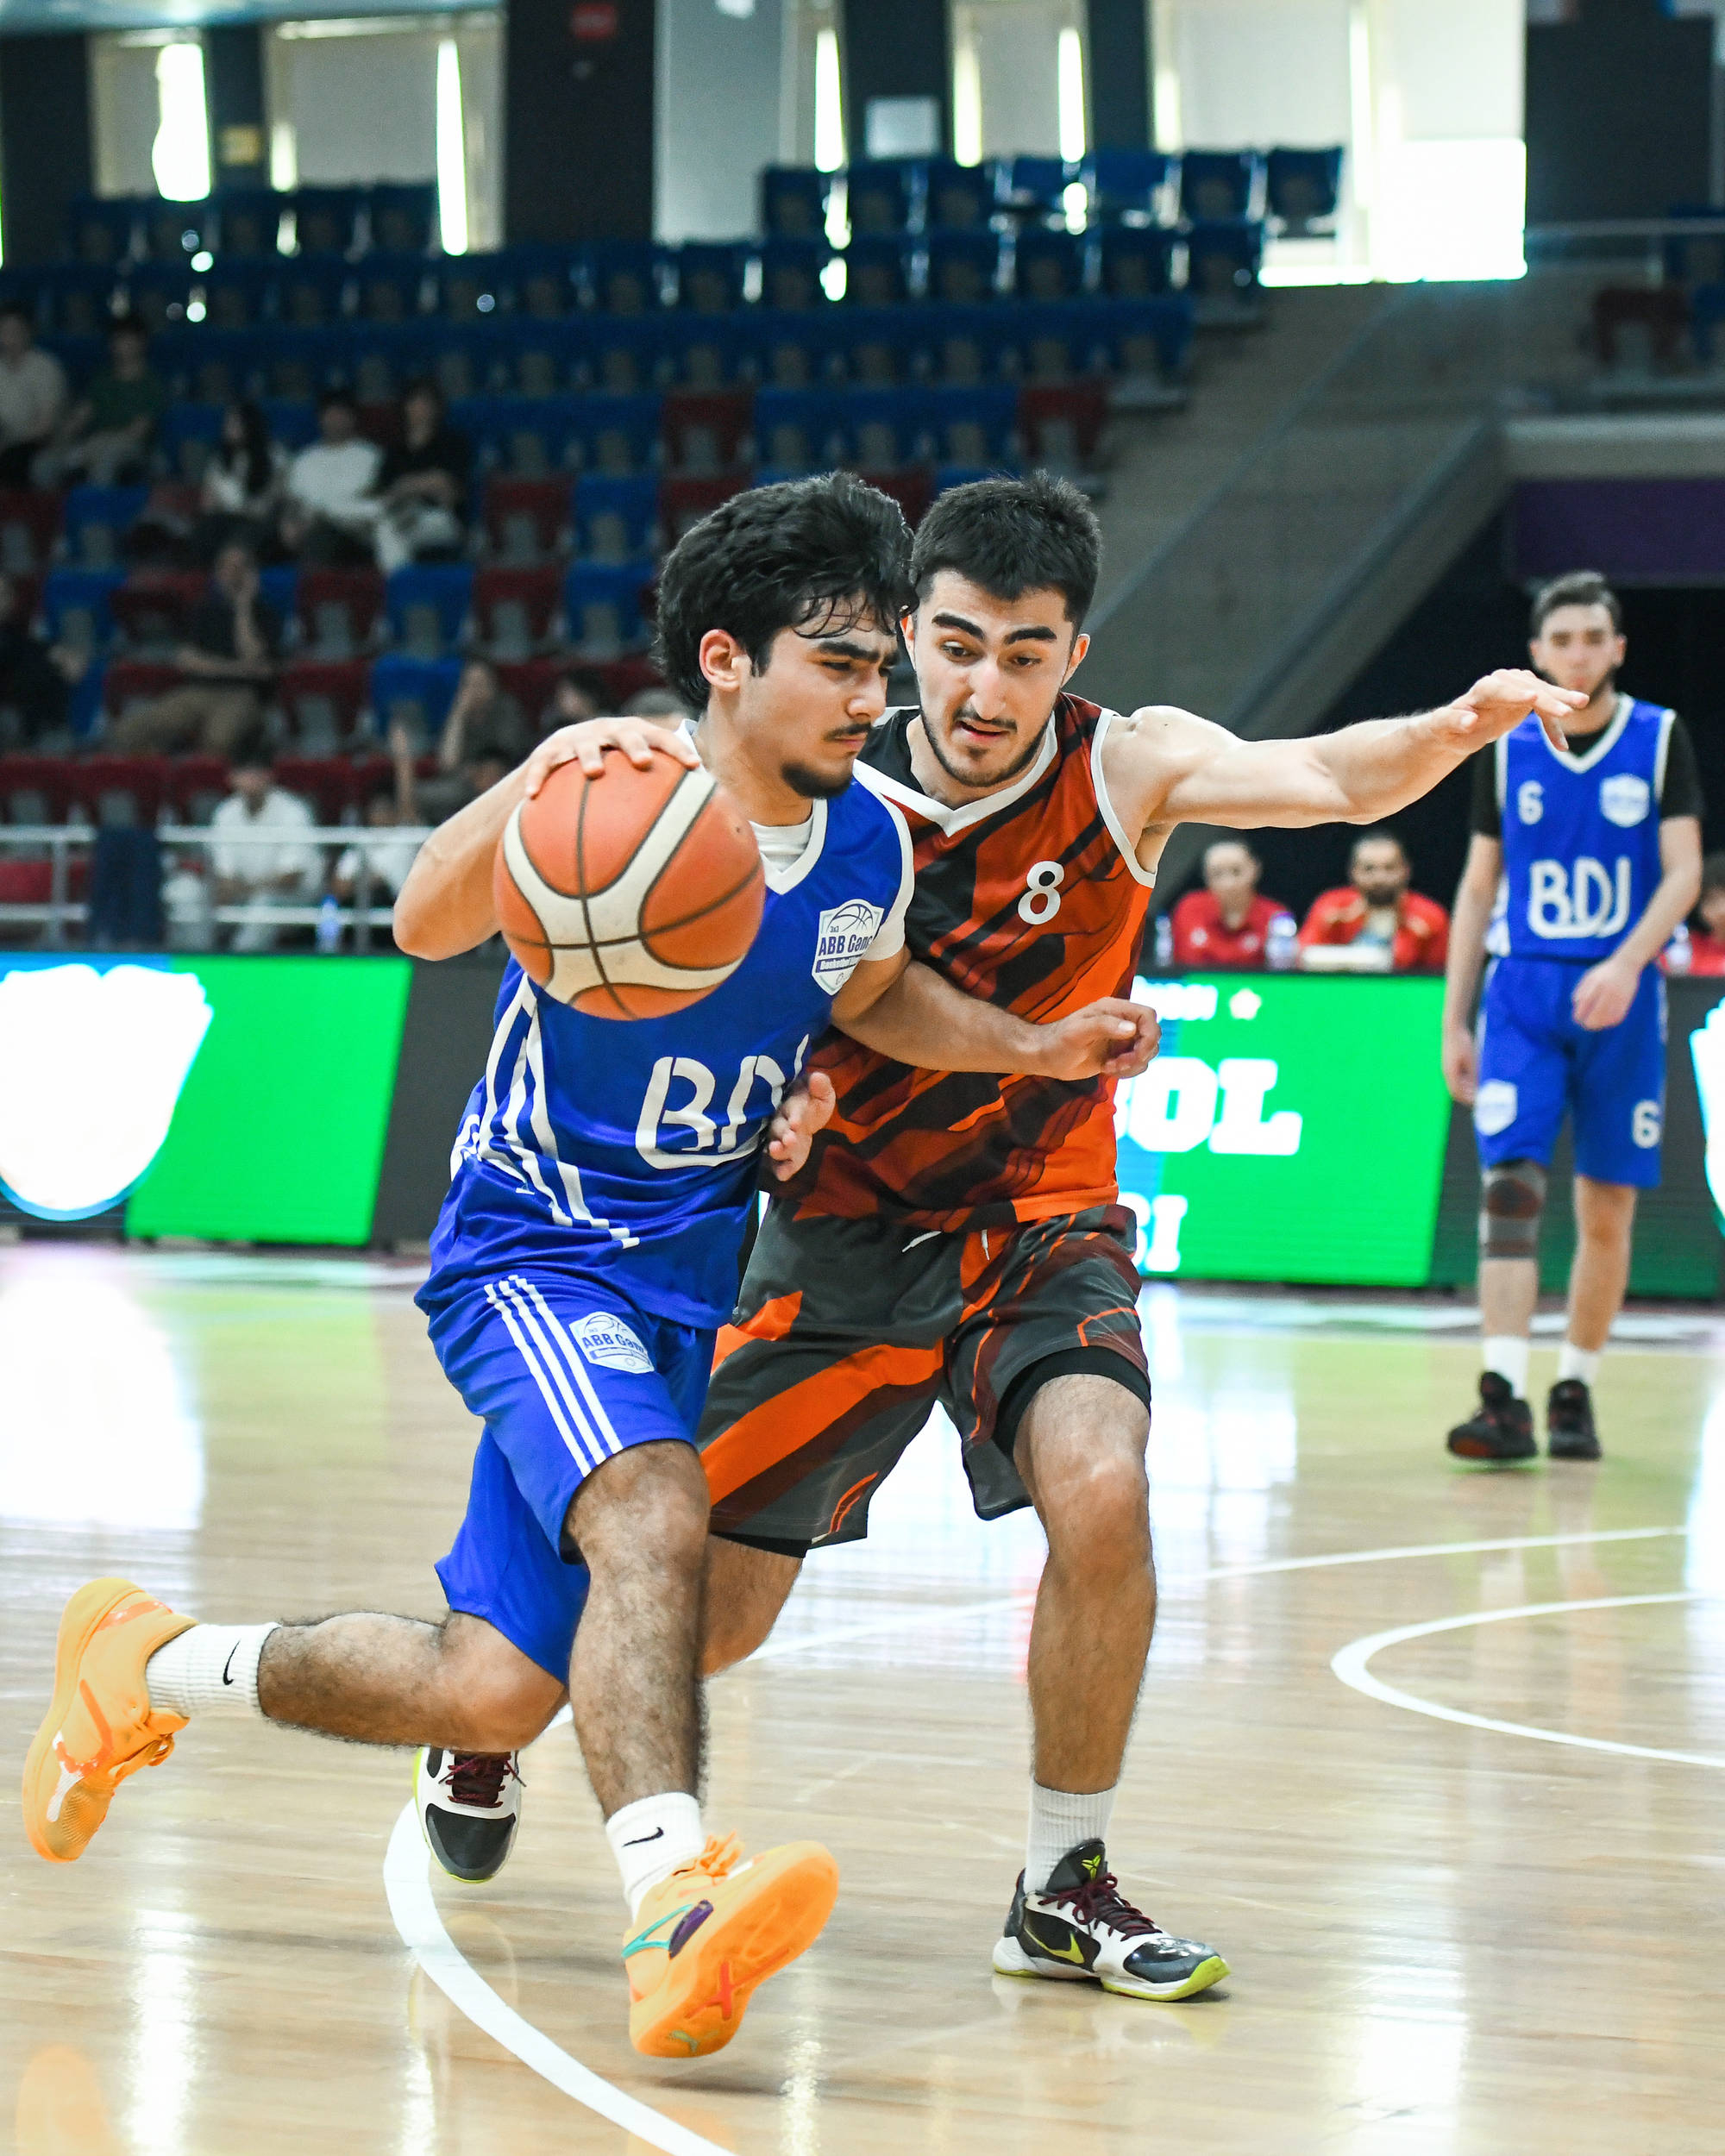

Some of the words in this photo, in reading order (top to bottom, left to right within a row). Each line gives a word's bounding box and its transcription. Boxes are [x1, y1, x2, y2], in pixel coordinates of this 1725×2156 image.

[1518, 780, 1544, 825] 6
[1018, 861, 1064, 924] 8
[819, 936, 845, 956] ABB
[1115, 1056, 1302, 1156] OL
[1632, 1099, 1661, 1148] 6
[582, 1333, 614, 1349] ABB
